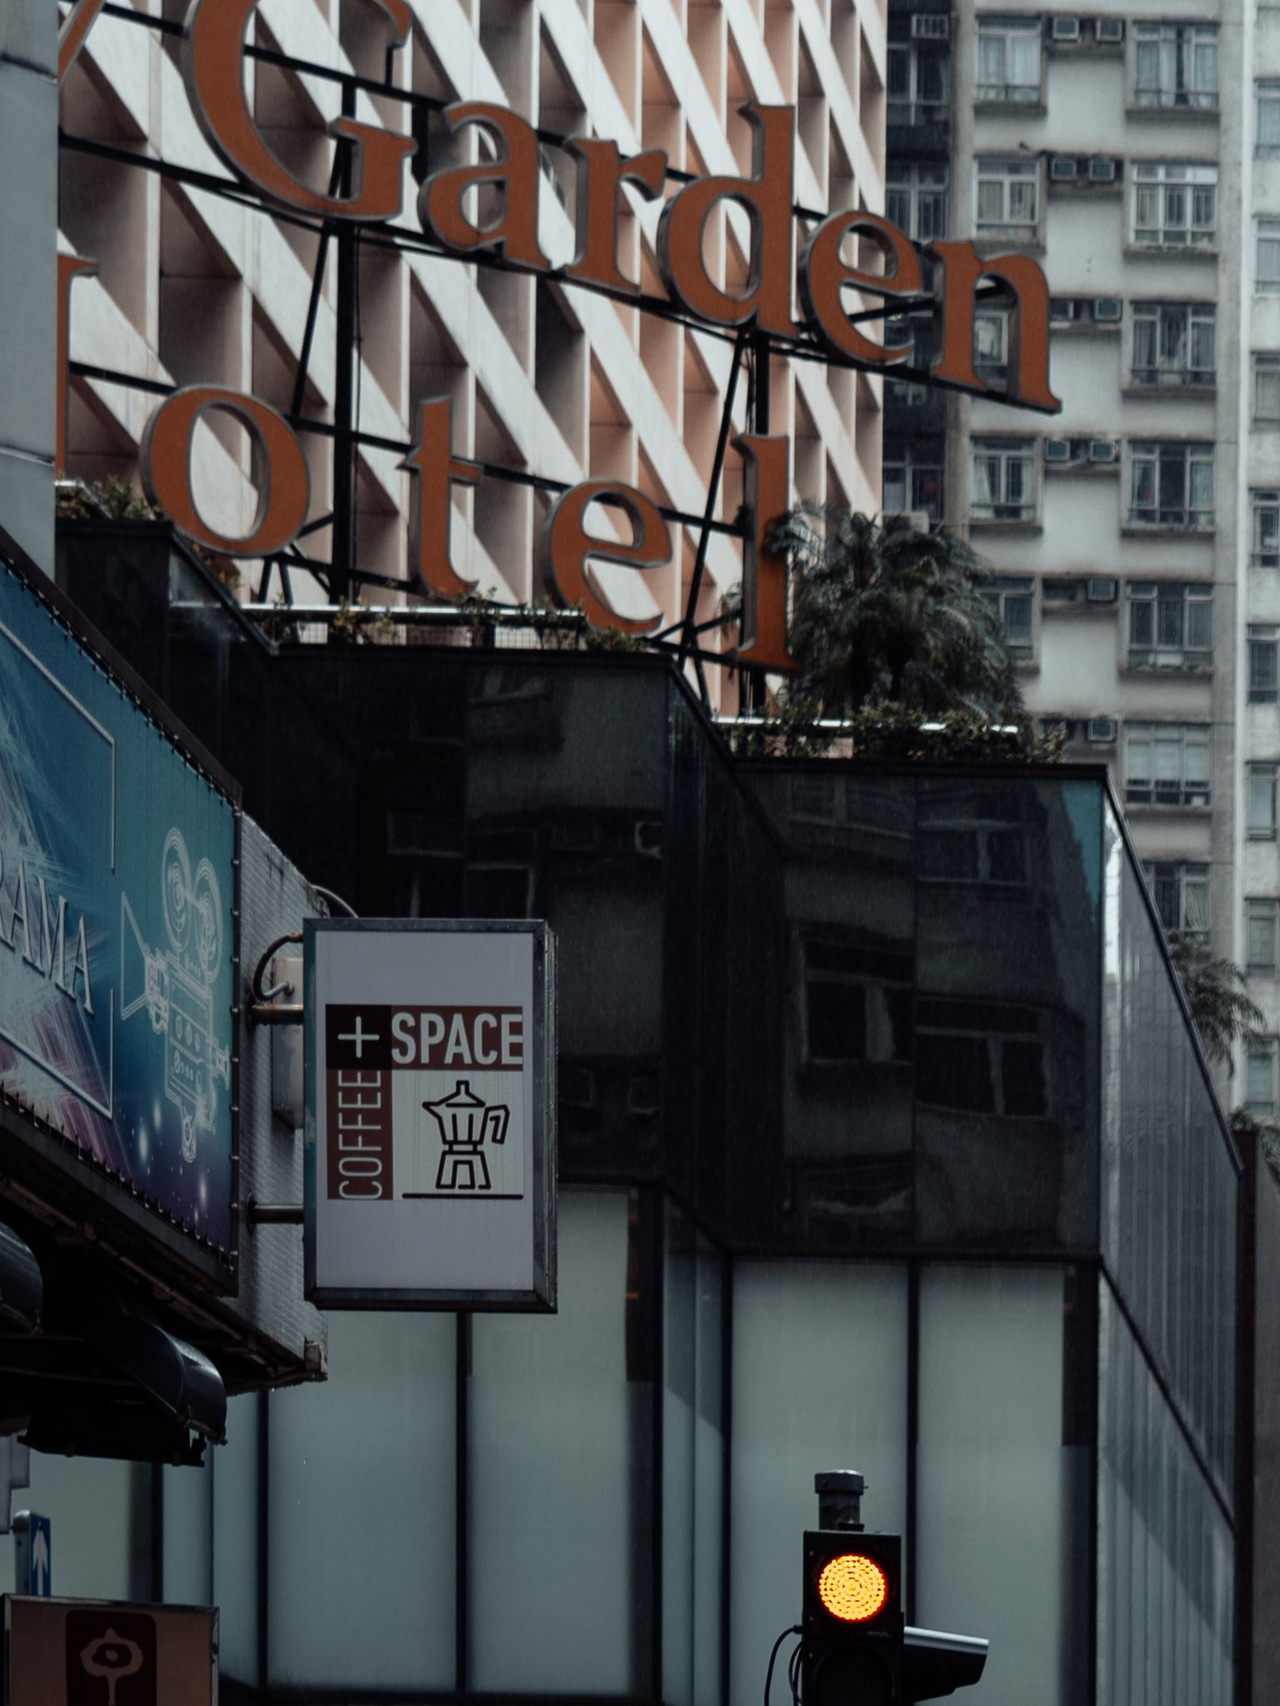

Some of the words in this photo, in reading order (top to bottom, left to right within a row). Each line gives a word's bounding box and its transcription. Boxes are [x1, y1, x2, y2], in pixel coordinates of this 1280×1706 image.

[182, 0, 1062, 414] Garden
[391, 1011, 524, 1065] SPACE
[337, 1070, 384, 1200] COFFEE
